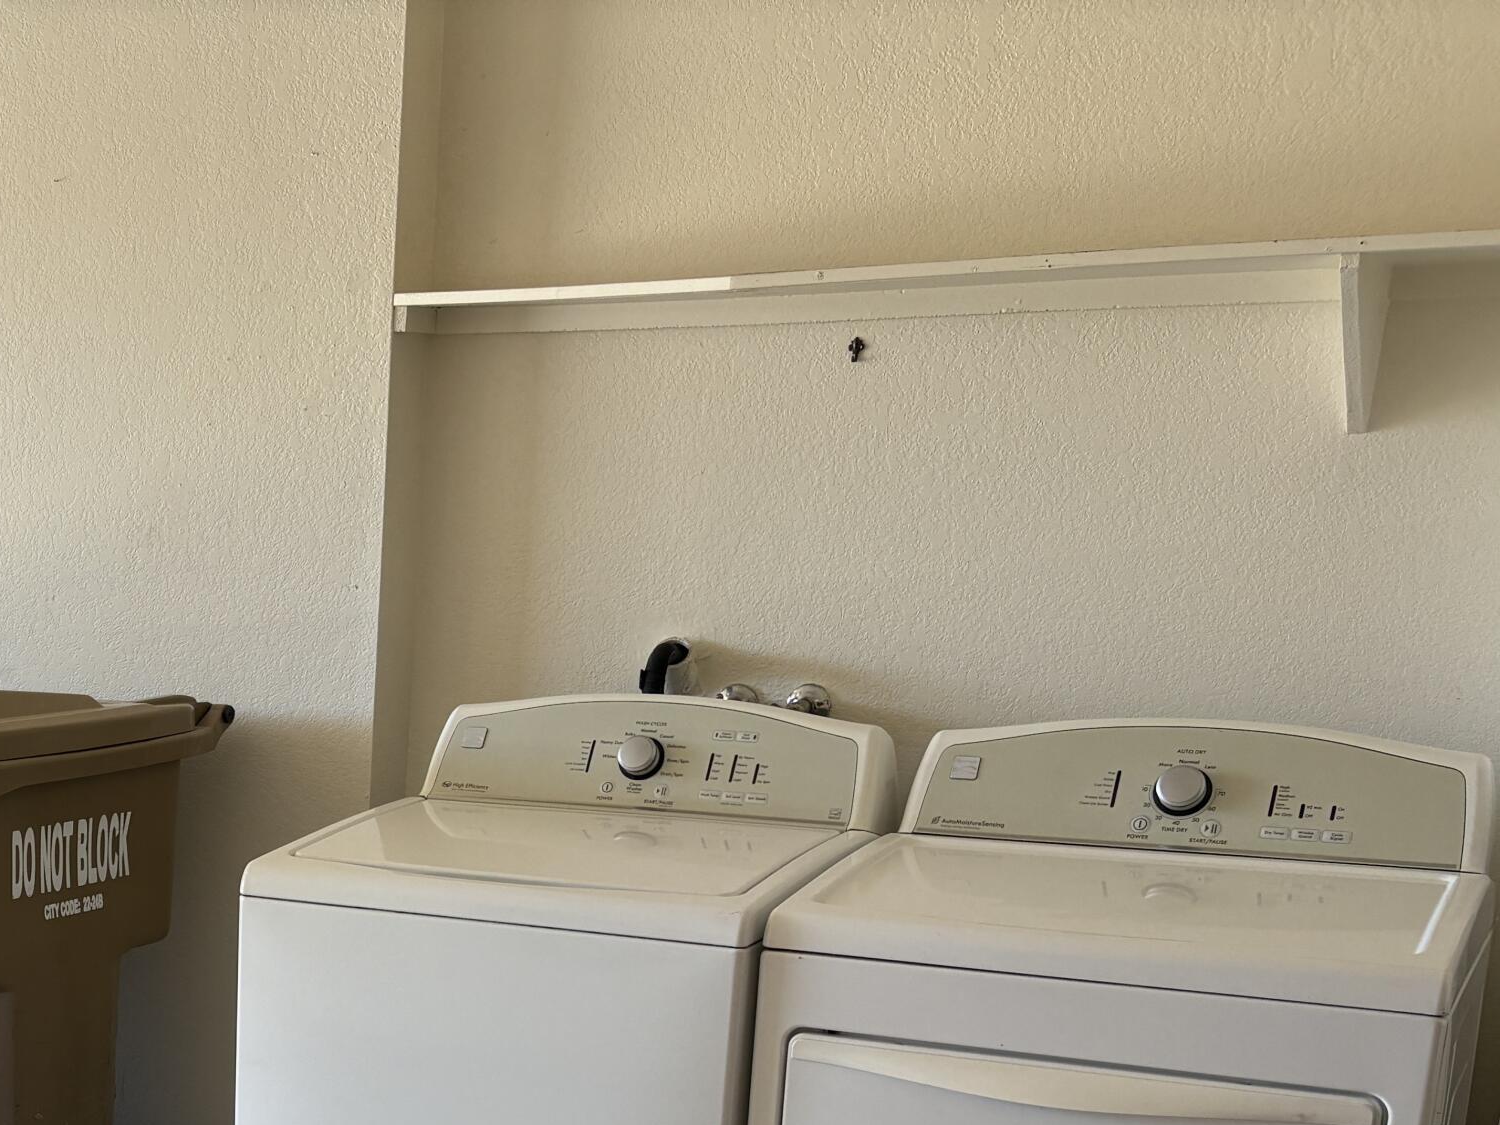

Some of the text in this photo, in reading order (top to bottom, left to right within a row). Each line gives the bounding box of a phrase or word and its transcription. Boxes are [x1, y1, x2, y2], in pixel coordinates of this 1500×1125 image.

[1188, 837, 1228, 845] START/PAUSE
[12, 811, 132, 900] DO NOT BLOCK
[44, 902, 60, 920] CITY
[60, 898, 81, 917] CODE:
